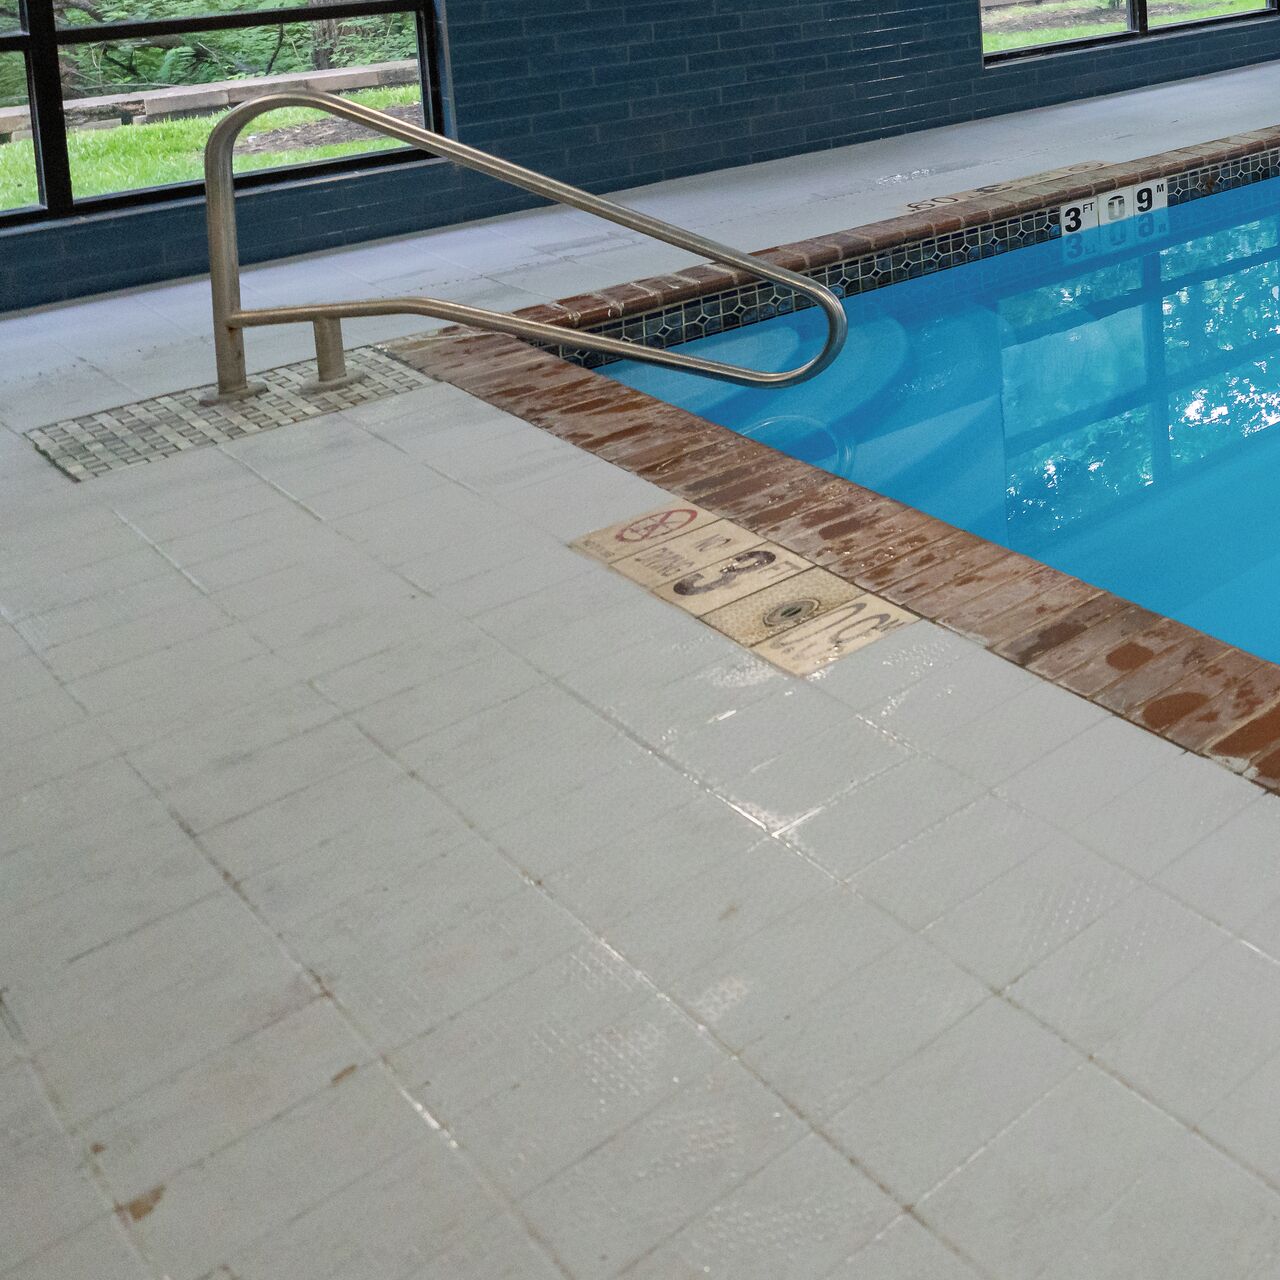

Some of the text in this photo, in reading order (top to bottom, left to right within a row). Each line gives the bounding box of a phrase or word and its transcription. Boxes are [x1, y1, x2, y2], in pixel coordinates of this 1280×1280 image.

[1064, 206, 1082, 233] 3
[1082, 201, 1095, 213] FT
[1136, 187, 1153, 213] 9
[1156, 184, 1165, 193] M
[633, 547, 694, 578] DIVING
[672, 550, 777, 596] 3
[758, 559, 812, 579] FT
